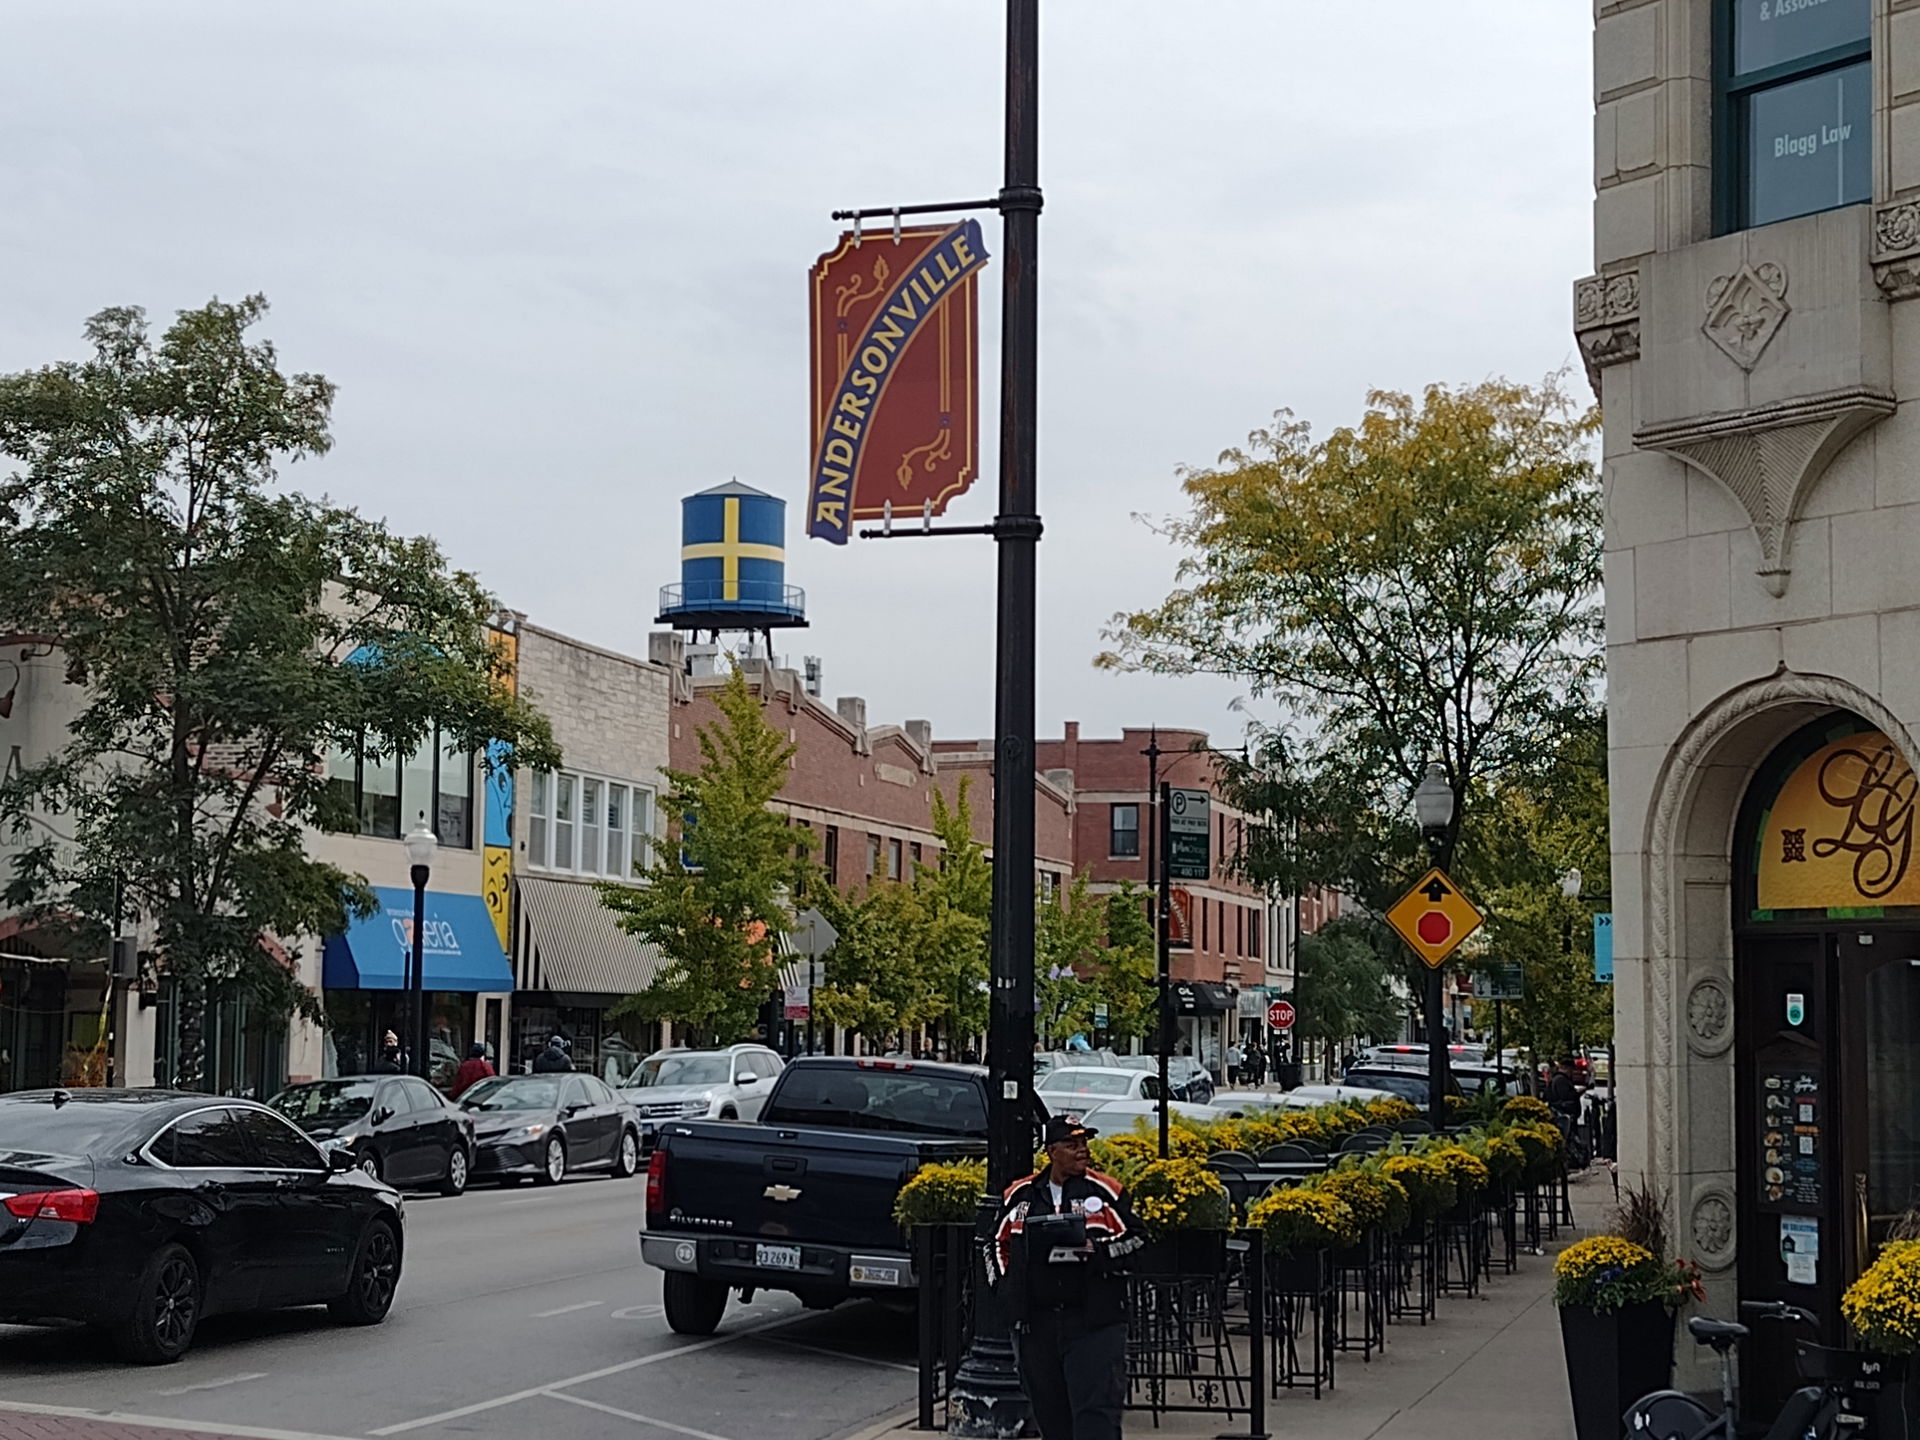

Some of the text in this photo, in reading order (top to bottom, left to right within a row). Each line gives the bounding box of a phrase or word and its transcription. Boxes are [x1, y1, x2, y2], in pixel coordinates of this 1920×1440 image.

[1760, 2, 1771, 20] &
[1775, 124, 1852, 157] Blagg Law
[816, 234, 977, 530] ANDERSONVILLE
[1269, 1009, 1293, 1021] STOP
[770, 1251, 787, 1265] 269
[1862, 1361, 1881, 1375] lyft
